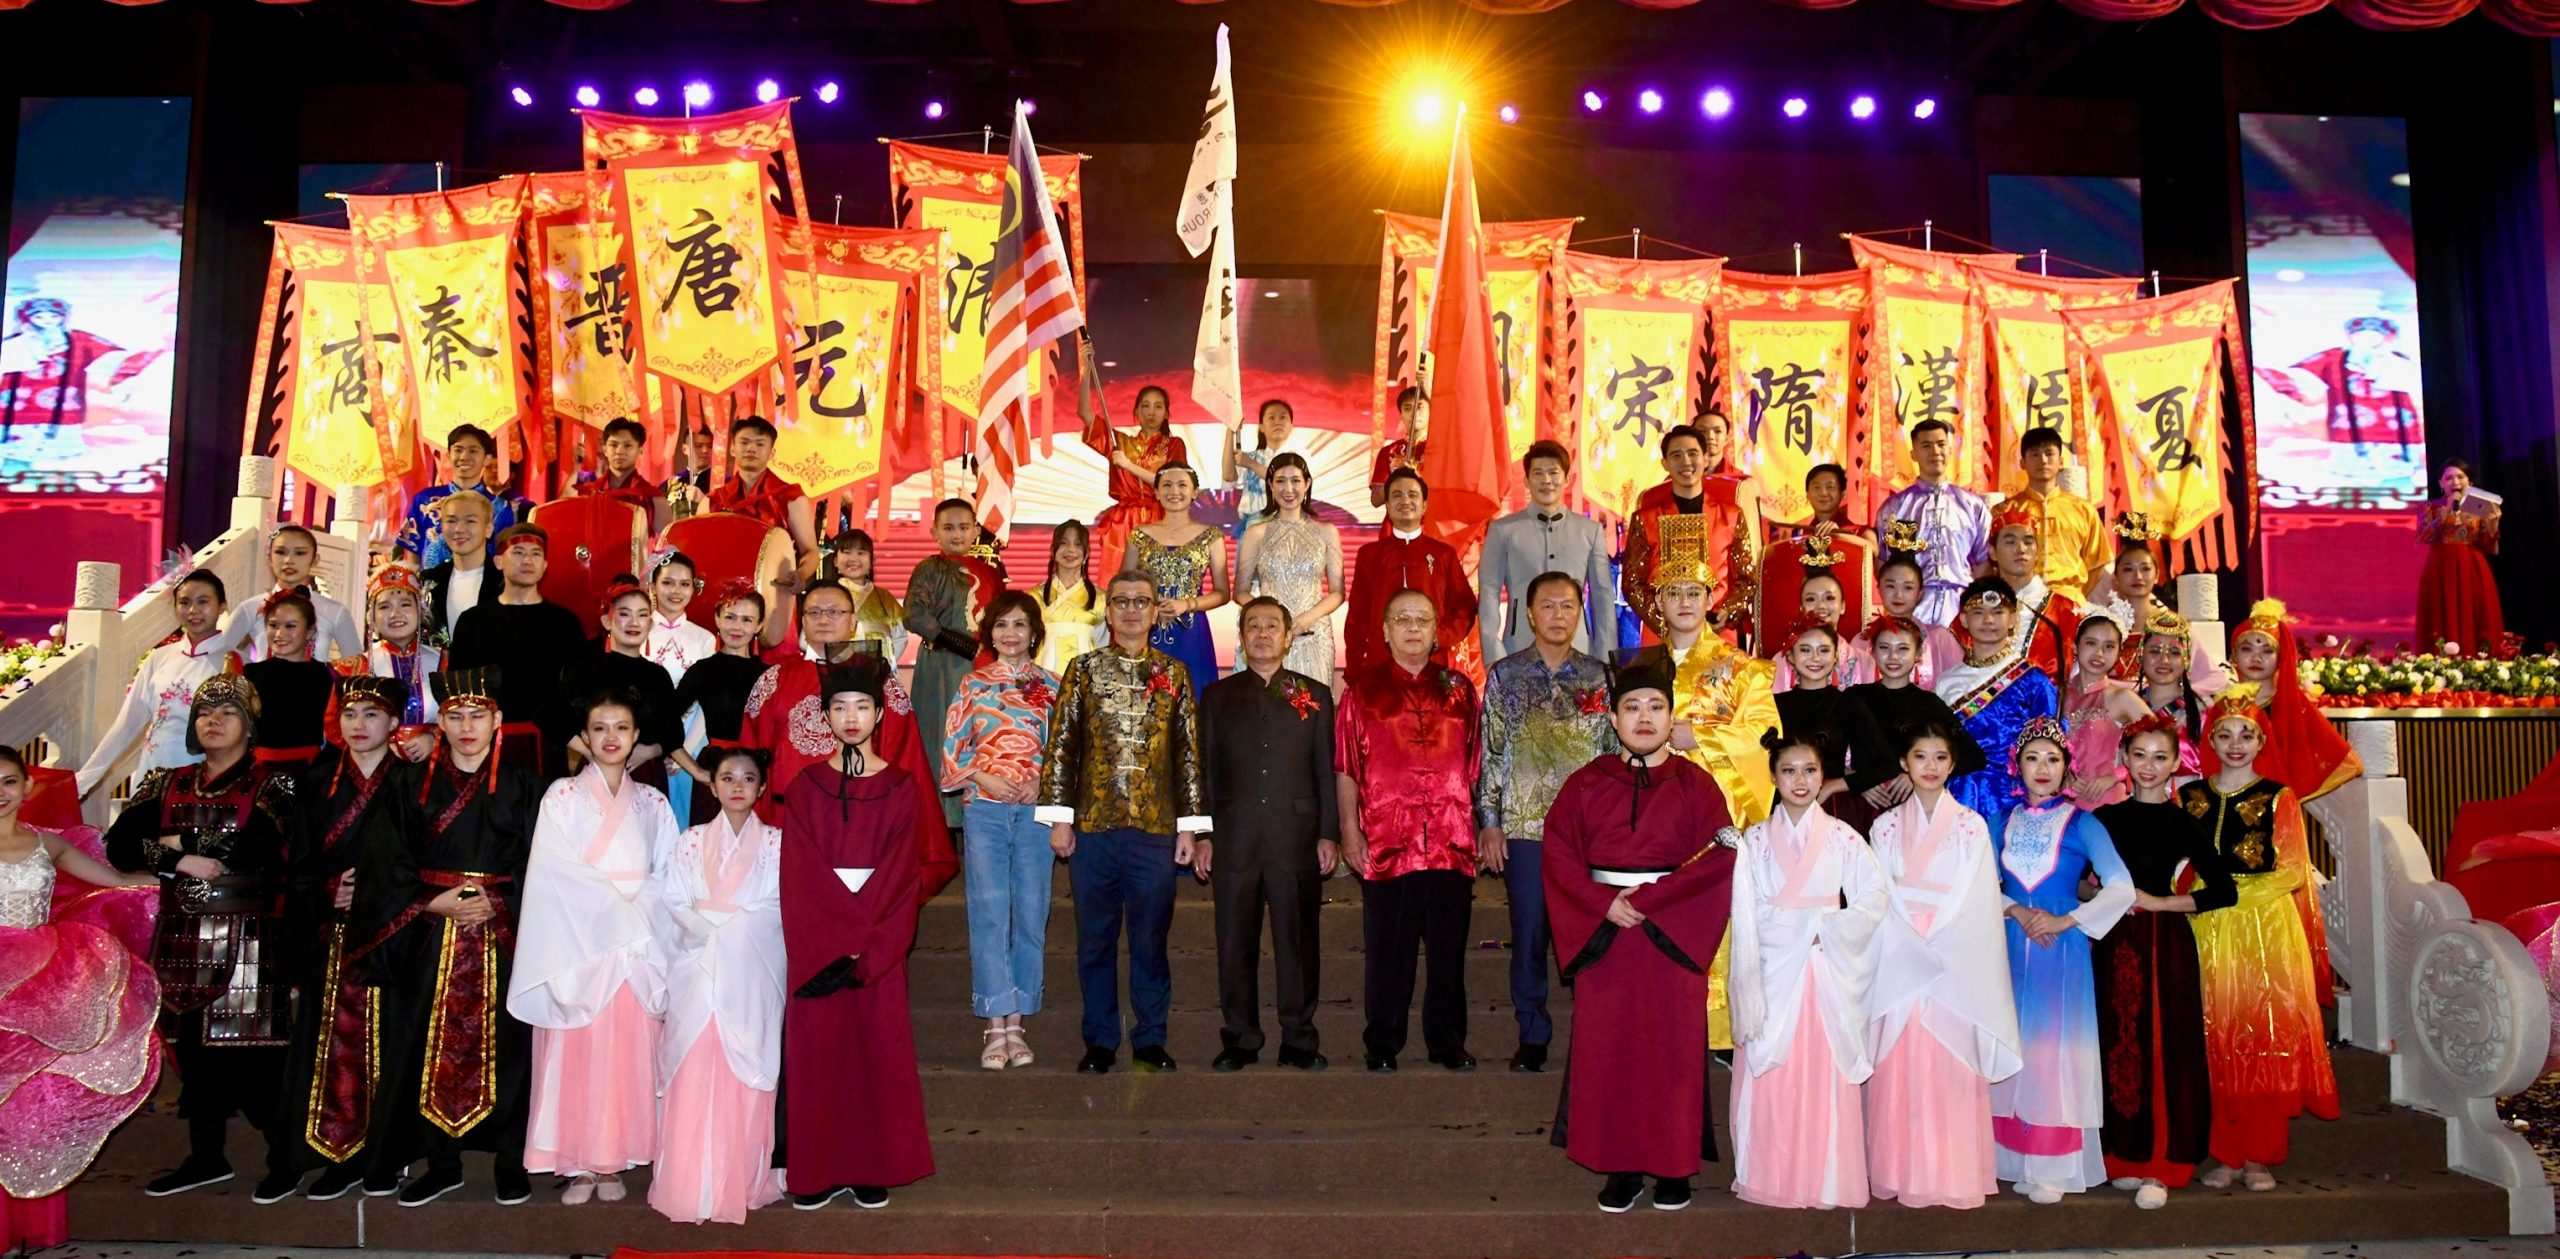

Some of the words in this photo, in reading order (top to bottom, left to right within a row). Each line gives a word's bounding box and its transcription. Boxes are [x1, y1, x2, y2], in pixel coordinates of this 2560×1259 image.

[661, 208, 743, 319] 唐
[320, 320, 402, 428] 商
[418, 285, 499, 384] 秦
[775, 320, 867, 418] 元
[1606, 354, 1674, 448] 宋
[1747, 361, 1825, 457] 隋
[1895, 346, 1960, 437] 漢
[2025, 367, 2076, 454] 周
[2136, 385, 2203, 473] 夏
